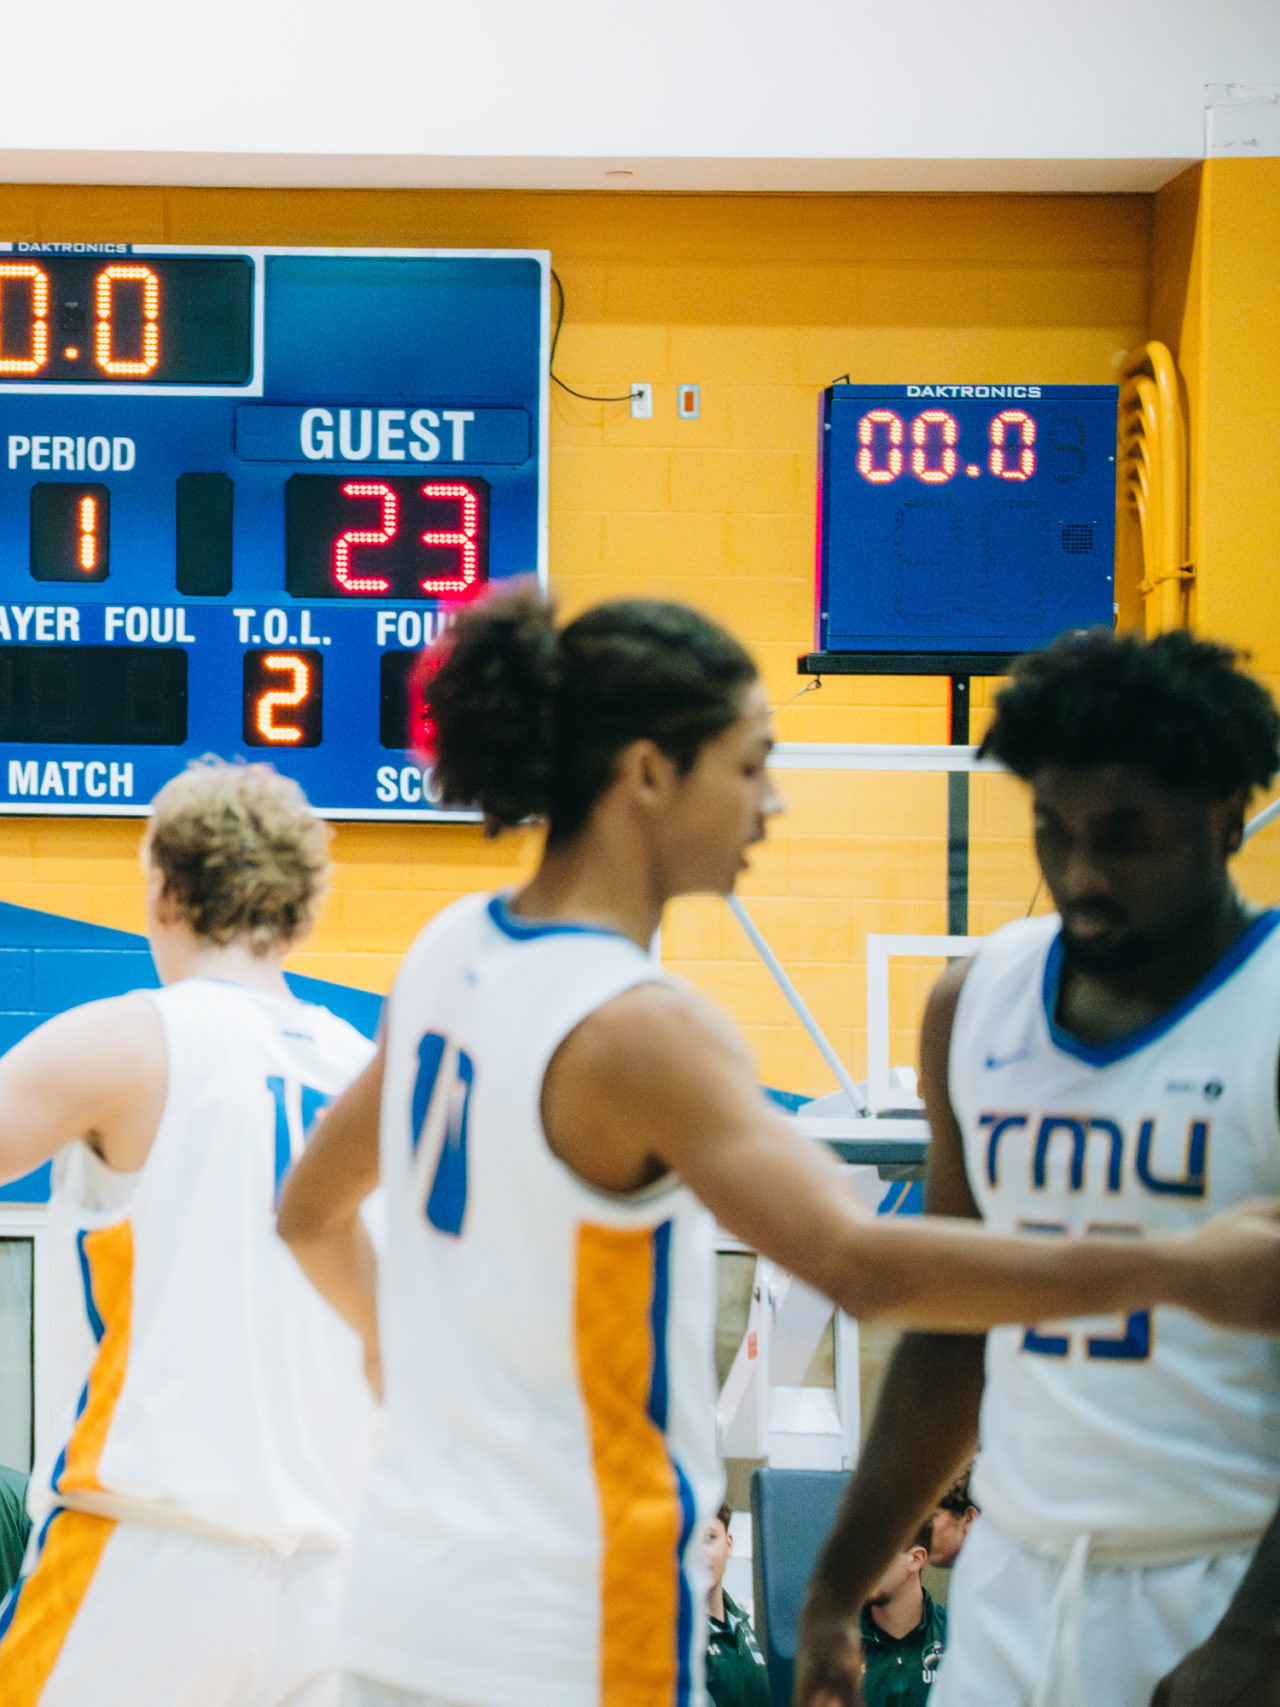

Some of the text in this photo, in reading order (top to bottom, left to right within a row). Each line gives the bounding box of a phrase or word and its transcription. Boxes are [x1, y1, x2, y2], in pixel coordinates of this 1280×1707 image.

[18, 242, 127, 254] DAKTRONICS
[907, 385, 1042, 398] DAKTRONICS
[299, 407, 475, 462] GUEST
[858, 410, 1037, 483] 00.0
[7, 435, 136, 472] PERIOD
[79, 496, 98, 570] 1
[334, 482, 478, 594] 23
[104, 607, 196, 644] FOUL
[233, 609, 332, 646] T.O.L.
[376, 611, 455, 647] FOU
[257, 655, 309, 743] 2
[8, 760, 134, 798] MATCH
[376, 766, 443, 803] SCO
